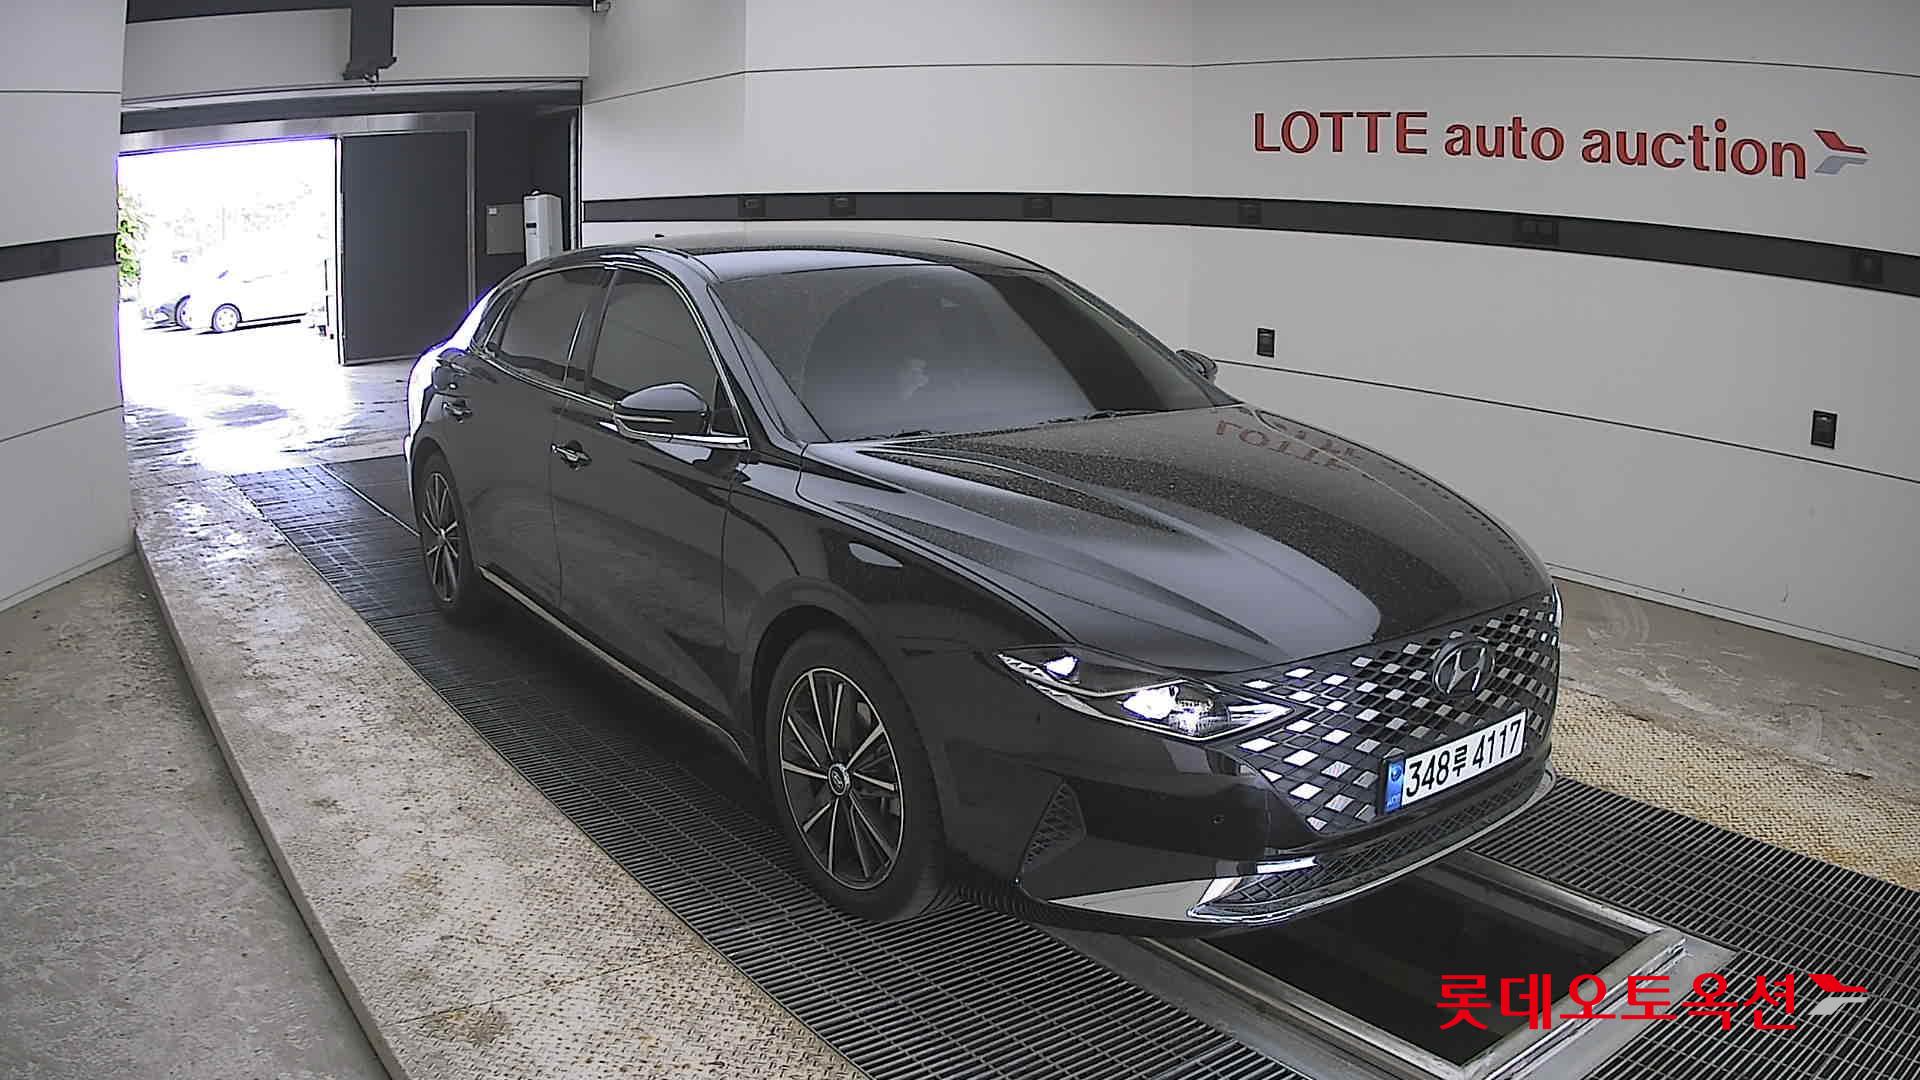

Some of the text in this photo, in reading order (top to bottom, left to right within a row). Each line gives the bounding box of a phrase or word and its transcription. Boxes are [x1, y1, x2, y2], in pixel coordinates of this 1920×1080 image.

[1254, 111, 1808, 180] LOTTE auto auction
[1405, 718, 1522, 798] 348루 4117
